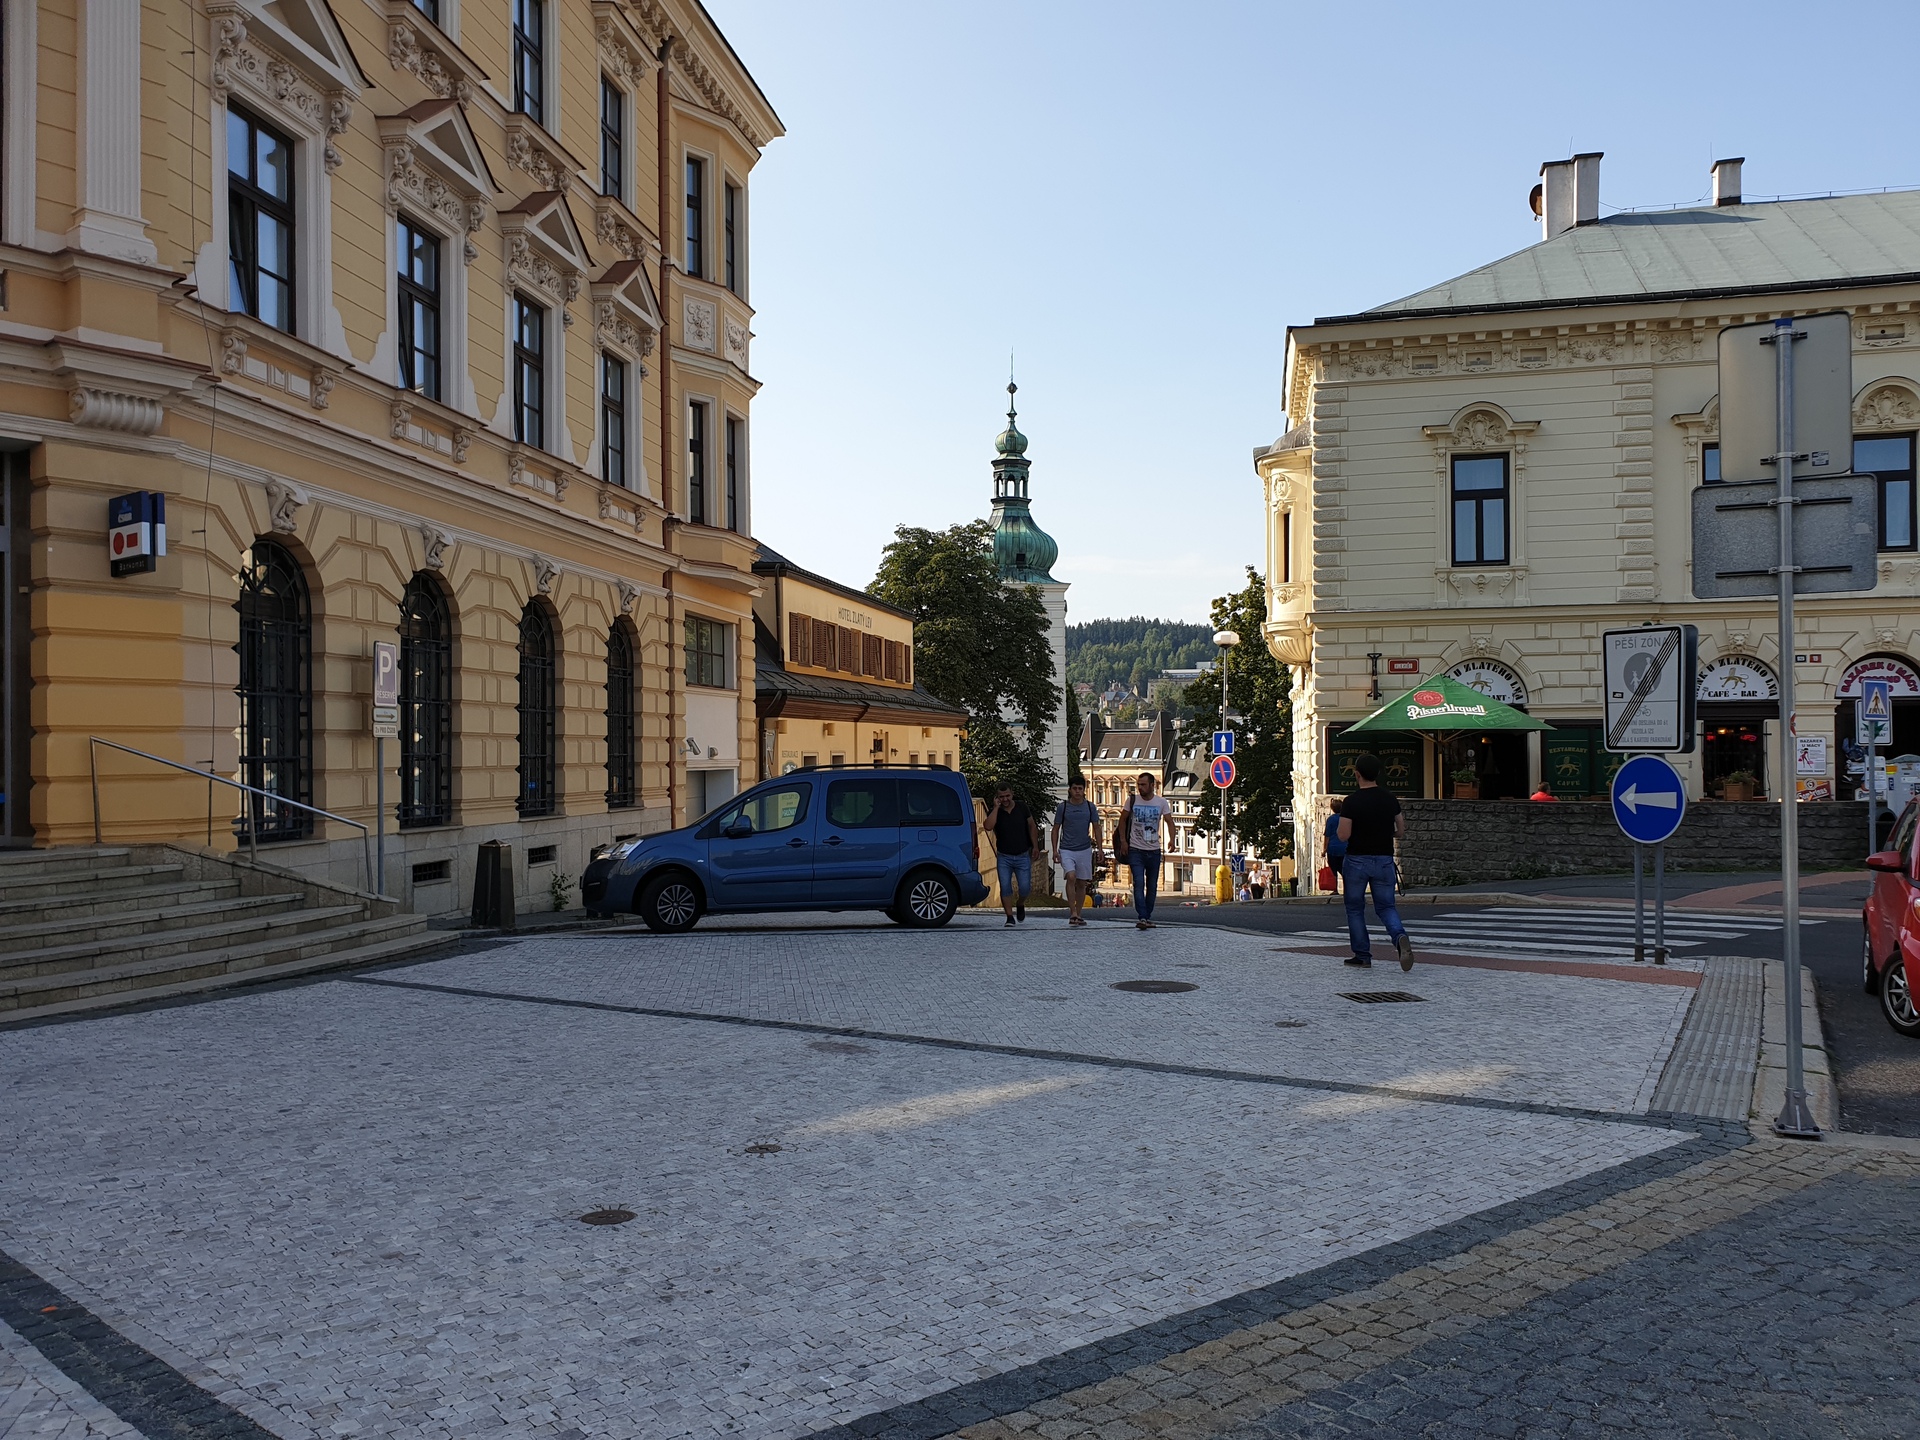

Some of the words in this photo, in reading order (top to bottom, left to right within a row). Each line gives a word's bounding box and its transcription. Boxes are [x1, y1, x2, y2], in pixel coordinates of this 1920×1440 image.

[837, 606, 852, 622] HOTEL
[852, 610, 865, 627] ZLATÝ
[865, 615, 873, 629] LEV
[1614, 636, 1637, 650] PĚŠÍ
[380, 650, 392, 686] P
[1706, 663, 1715, 673] U
[1718, 657, 1768, 678] ZLATÉHO
[1765, 677, 1778, 697] LVA
[1840, 661, 1884, 693] BAZÁREK
[1886, 662, 1896, 672] U
[1895, 666, 1919, 692] MÁCY
[1453, 669, 1463, 678] U
[1463, 661, 1513, 684] ZLATÉHO
[1510, 680, 1524, 701] LVA
[1708, 689, 1730, 698] CAFÉ
[1407, 704, 1446, 720] Pilsner
[1444, 703, 1486, 715] Urquell
[1549, 746, 1588, 754] RESTAURANT
